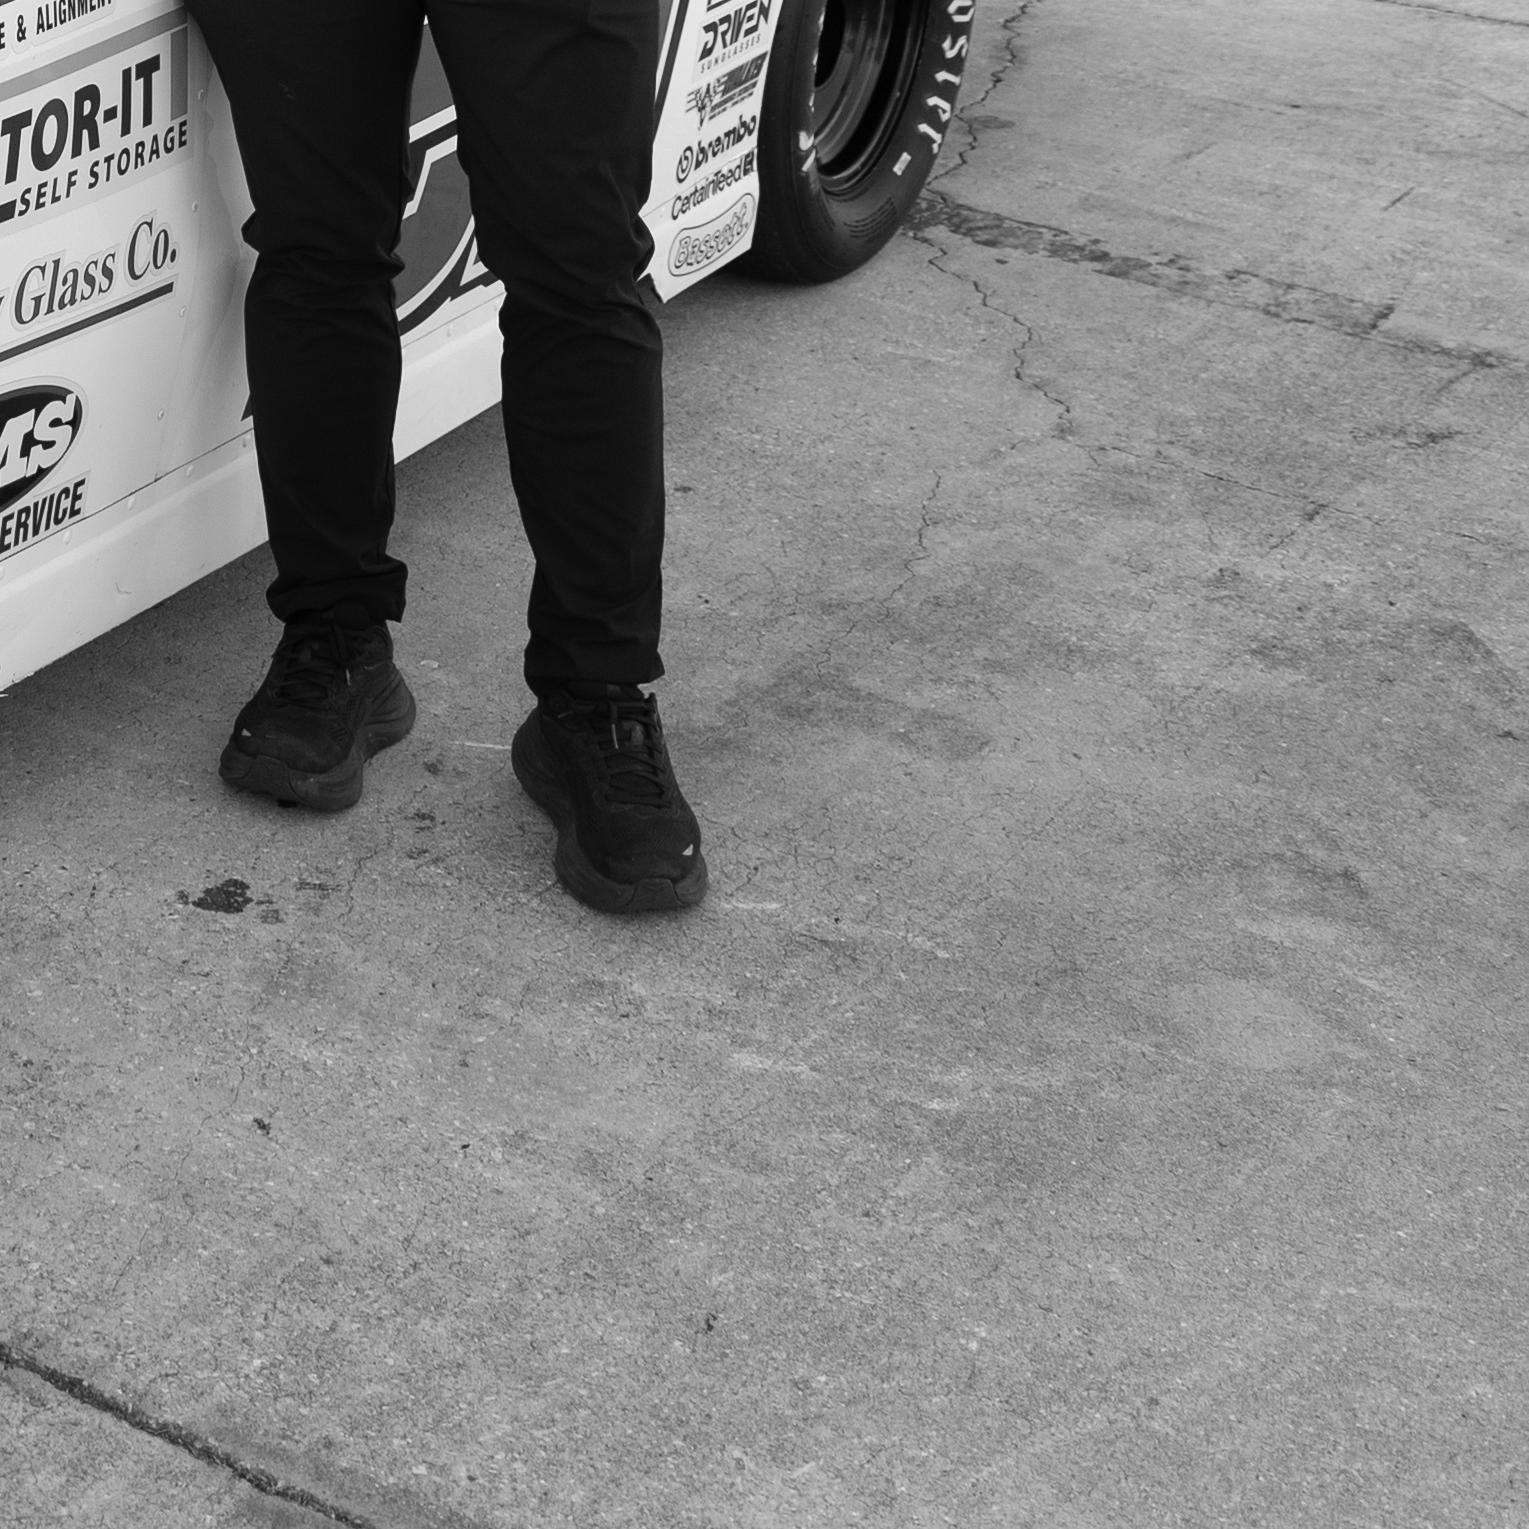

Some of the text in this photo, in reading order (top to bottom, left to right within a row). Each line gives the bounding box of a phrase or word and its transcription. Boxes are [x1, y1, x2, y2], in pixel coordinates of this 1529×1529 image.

[16, 13, 28, 43] &
[700, 33, 762, 75] SUNGLASSES
[17, 119, 188, 217] SELF STORAGE
[694, 114, 757, 172] brembo
[671, 158, 743, 221] CertainTeed
[14, 250, 118, 325] Glass
[127, 217, 178, 281] Co.
